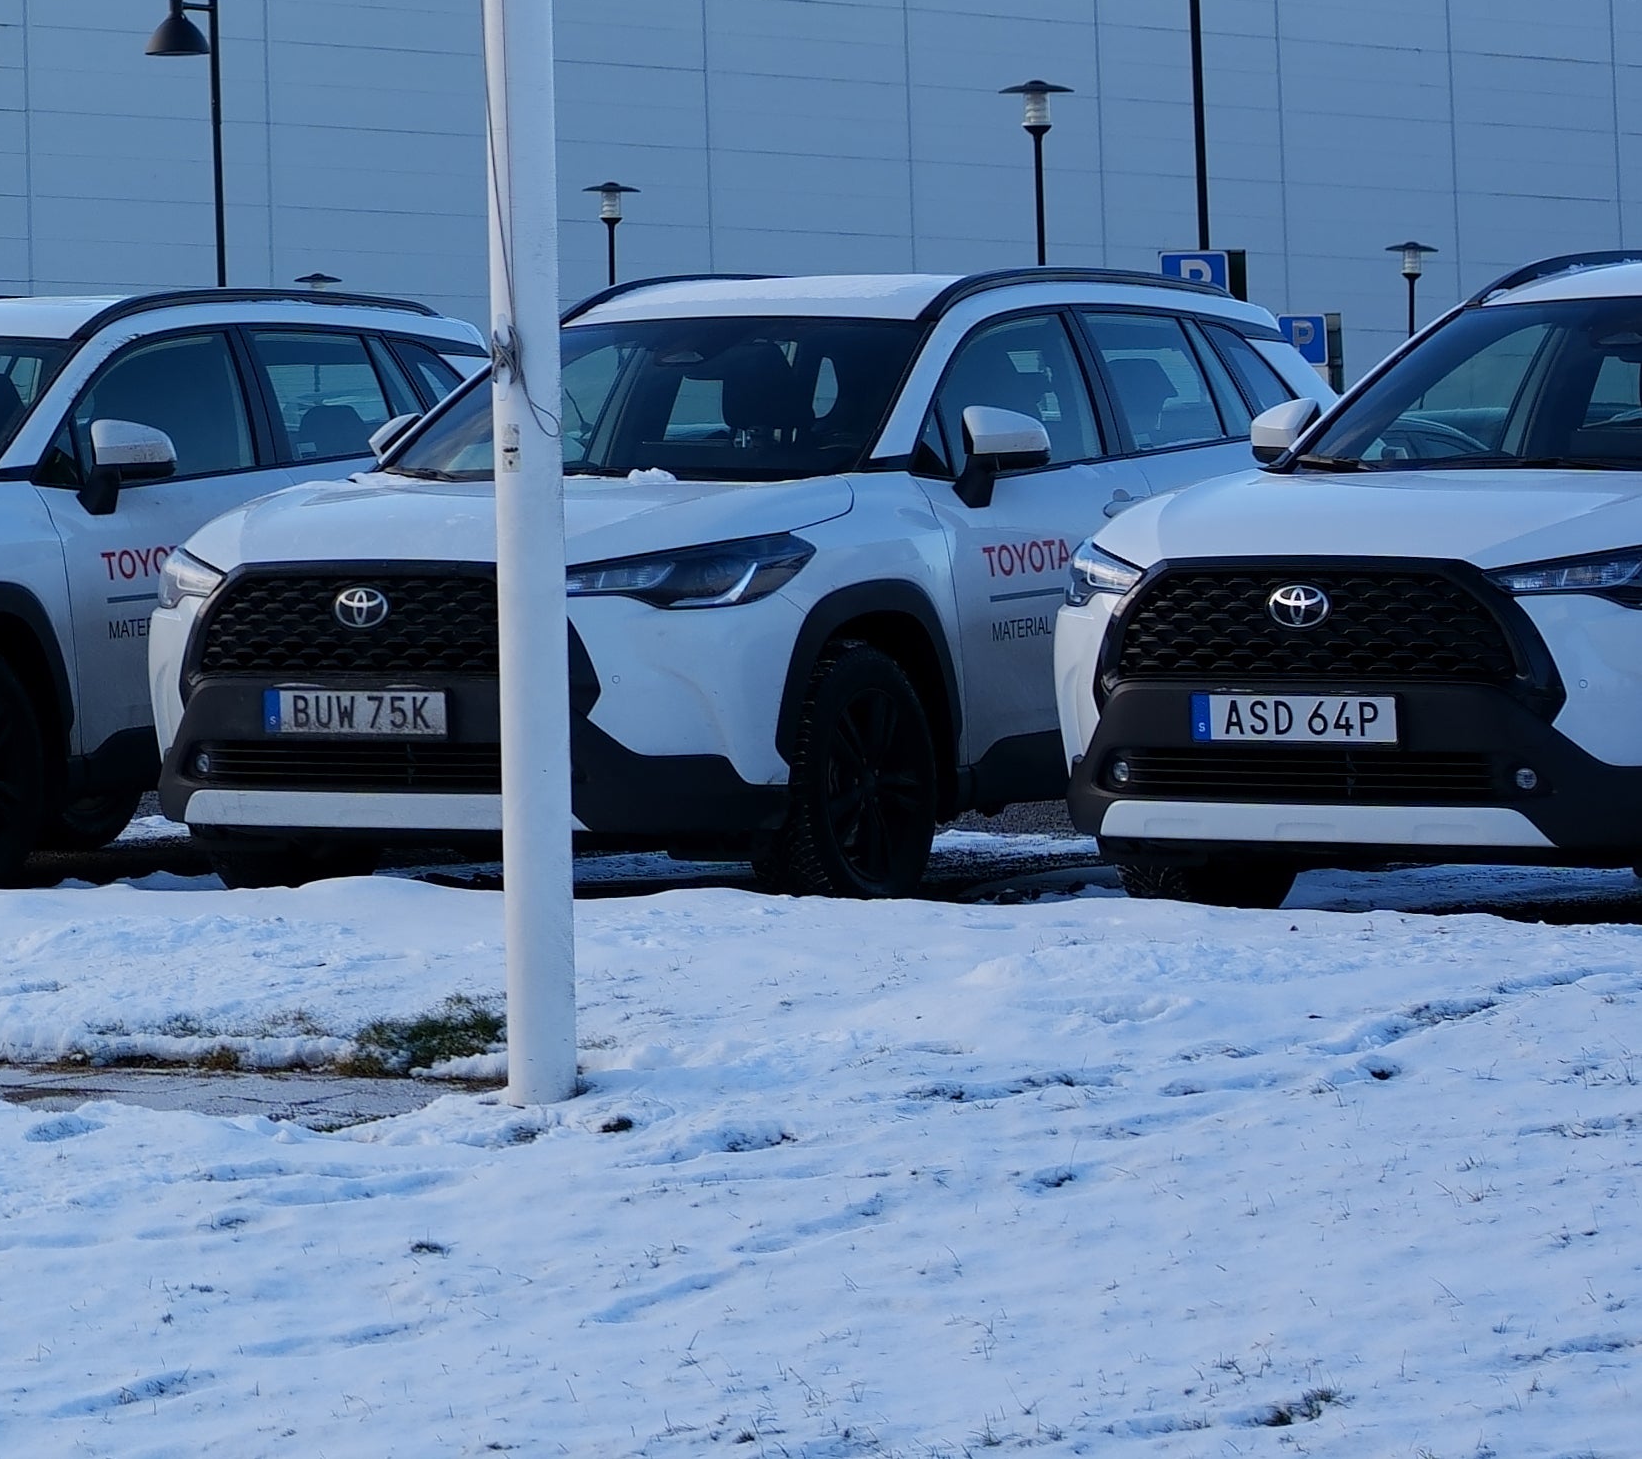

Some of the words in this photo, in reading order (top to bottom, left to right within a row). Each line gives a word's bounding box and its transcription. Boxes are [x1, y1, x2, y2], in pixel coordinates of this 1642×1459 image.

[1292, 320, 1315, 353] P
[100, 545, 178, 581] TOYO
[980, 539, 1070, 577] TOYOTA
[991, 615, 1053, 642] MATERIAL
[292, 694, 355, 729] BUW
[367, 695, 430, 730] 75K
[1198, 722, 1206, 732] S
[1224, 699, 1294, 736] ASD
[1307, 700, 1379, 737] 64P
